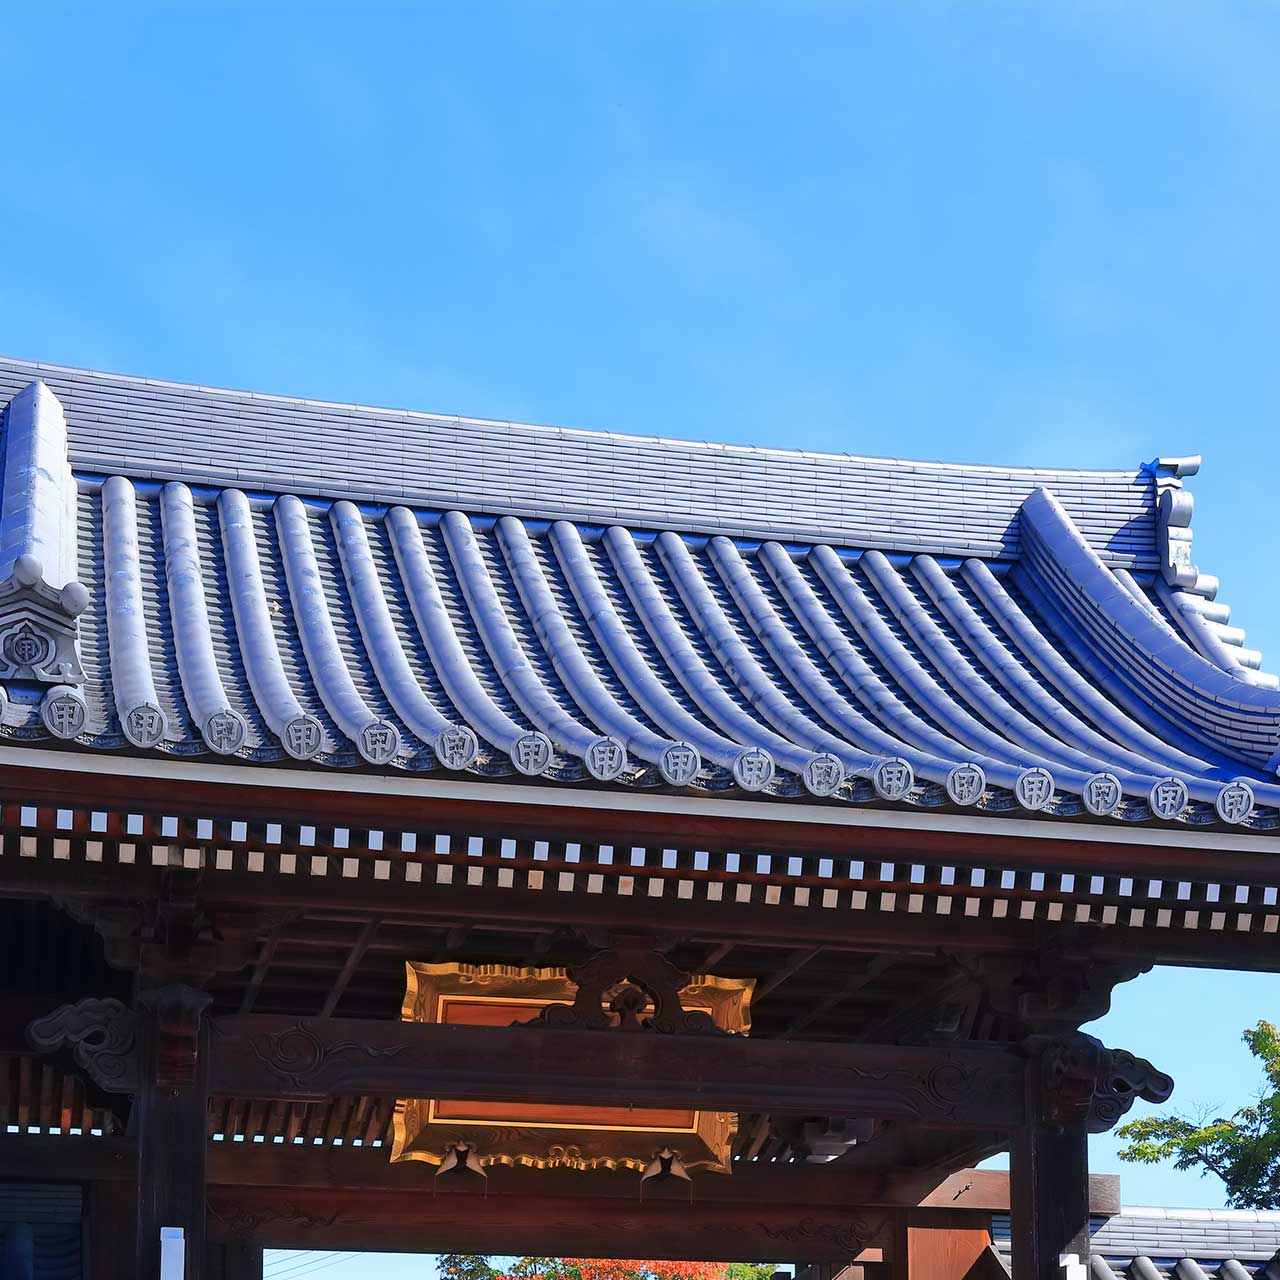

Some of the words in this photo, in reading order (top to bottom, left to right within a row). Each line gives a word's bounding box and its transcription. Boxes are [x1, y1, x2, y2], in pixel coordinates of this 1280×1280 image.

[50, 702, 79, 735] 甲
[132, 712, 159, 744] 甲
[291, 724, 319, 755] 甲
[1025, 777, 1049, 807] 甲
[1159, 786, 1183, 816] 甲
[1225, 791, 1249, 821] 甲
